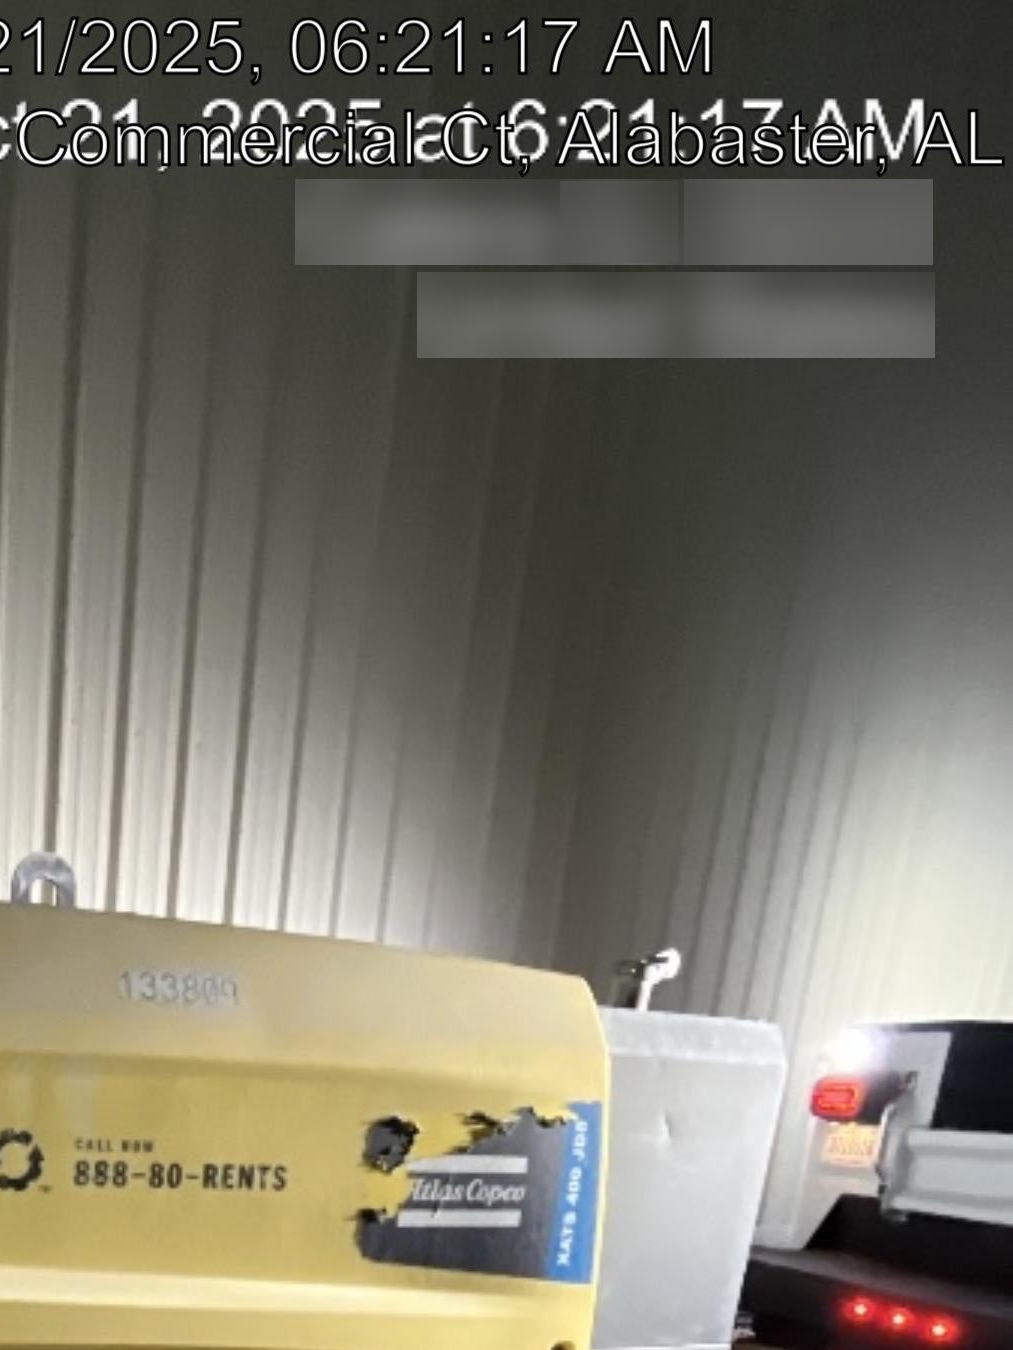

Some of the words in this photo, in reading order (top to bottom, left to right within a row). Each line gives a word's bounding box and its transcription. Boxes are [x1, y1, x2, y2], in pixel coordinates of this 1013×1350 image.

[74, 1139, 115, 1151] CALL
[73, 1160, 288, 1192] 888-80-RENTS
[466, 1177, 526, 1207] Copco
